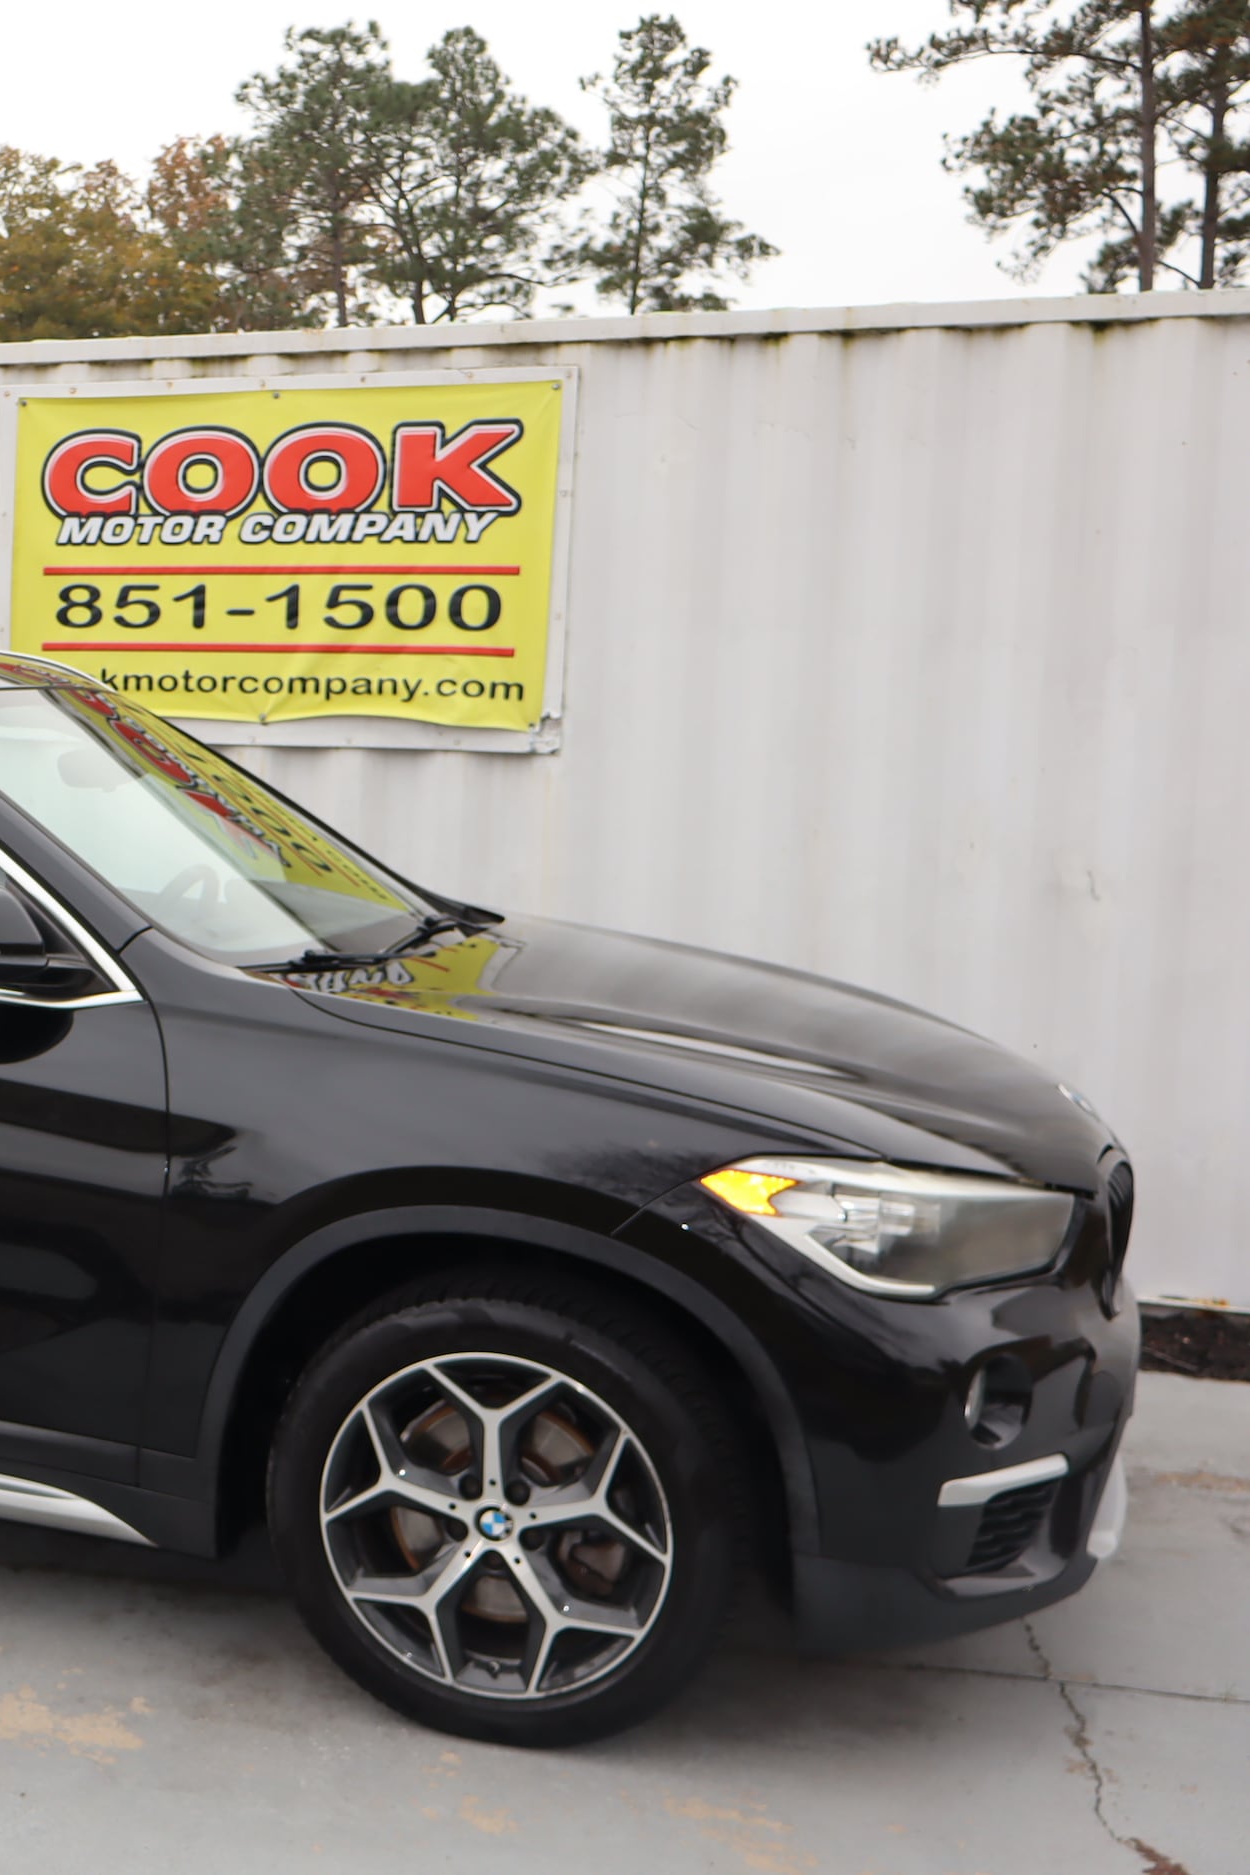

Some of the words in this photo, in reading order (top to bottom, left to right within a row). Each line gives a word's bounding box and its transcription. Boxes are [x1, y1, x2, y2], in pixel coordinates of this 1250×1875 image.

[42, 419, 523, 520] COOK
[56, 513, 227, 545] MOTOR
[238, 512, 501, 544] COMPANY
[55, 584, 502, 631] 851-1500
[95, 668, 525, 702] kmotorcompany.com
